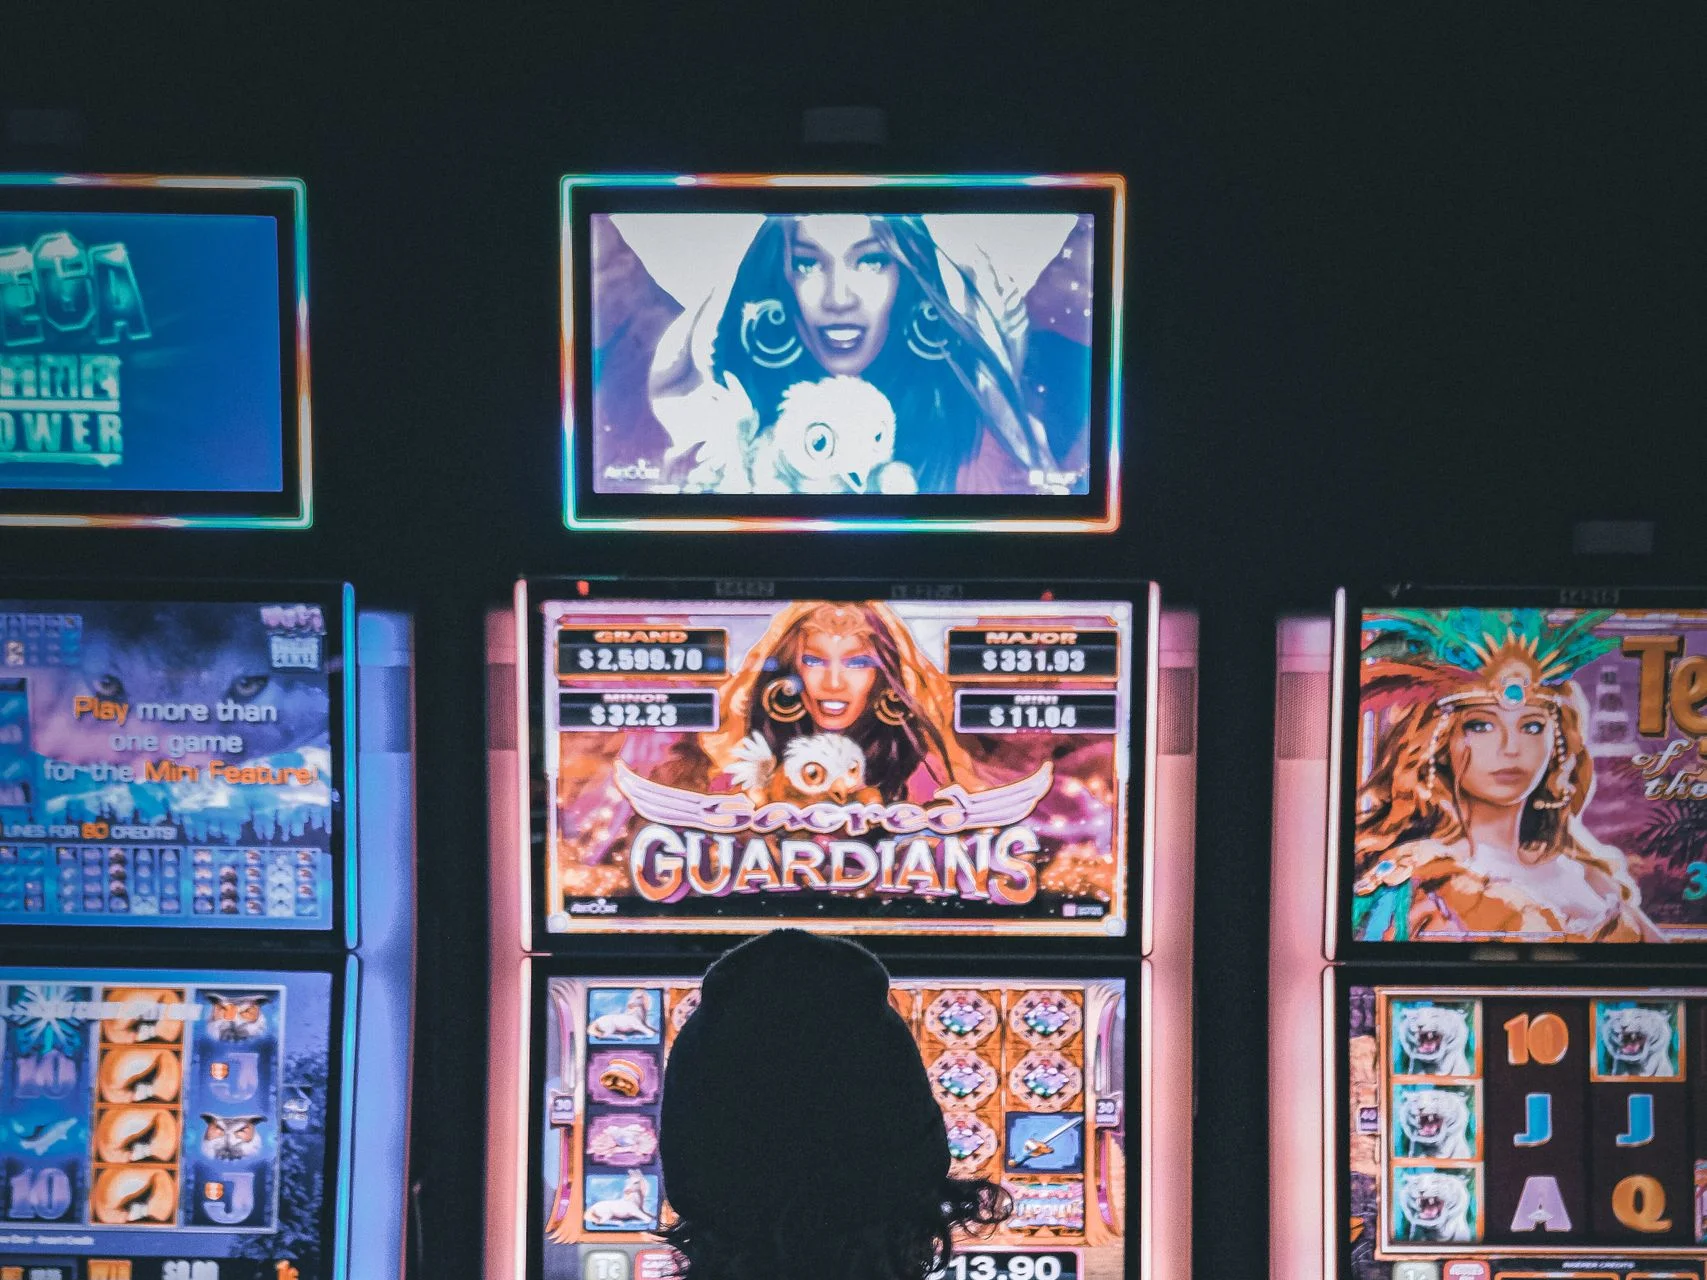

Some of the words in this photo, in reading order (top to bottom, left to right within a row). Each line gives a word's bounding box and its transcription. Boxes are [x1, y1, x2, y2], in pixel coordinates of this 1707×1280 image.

[593, 631, 688, 644] GRAND
[985, 632, 1078, 645] MAJOR
[982, 650, 1085, 672] $331.93
[73, 695, 129, 725] Play
[137, 702, 209, 722] more
[216, 698, 278, 722] than
[602, 694, 669, 704] MINOR
[110, 733, 159, 752] one
[167, 733, 243, 757] game
[1631, 739, 1696, 780] of
[43, 758, 84, 782] for
[91, 760, 134, 783] the
[144, 760, 199, 783] Mini
[698, 785, 974, 836] Sacred
[49, 825, 79, 838] FOR
[630, 825, 1040, 905] GUARDIANS
[1503, 1012, 1569, 1066] 10
[1513, 1093, 1553, 1147] J
[1616, 1093, 1655, 1147] J
[9, 1167, 72, 1219] 10
[1510, 1175, 1572, 1232] A
[1612, 1174, 1672, 1233] Q
